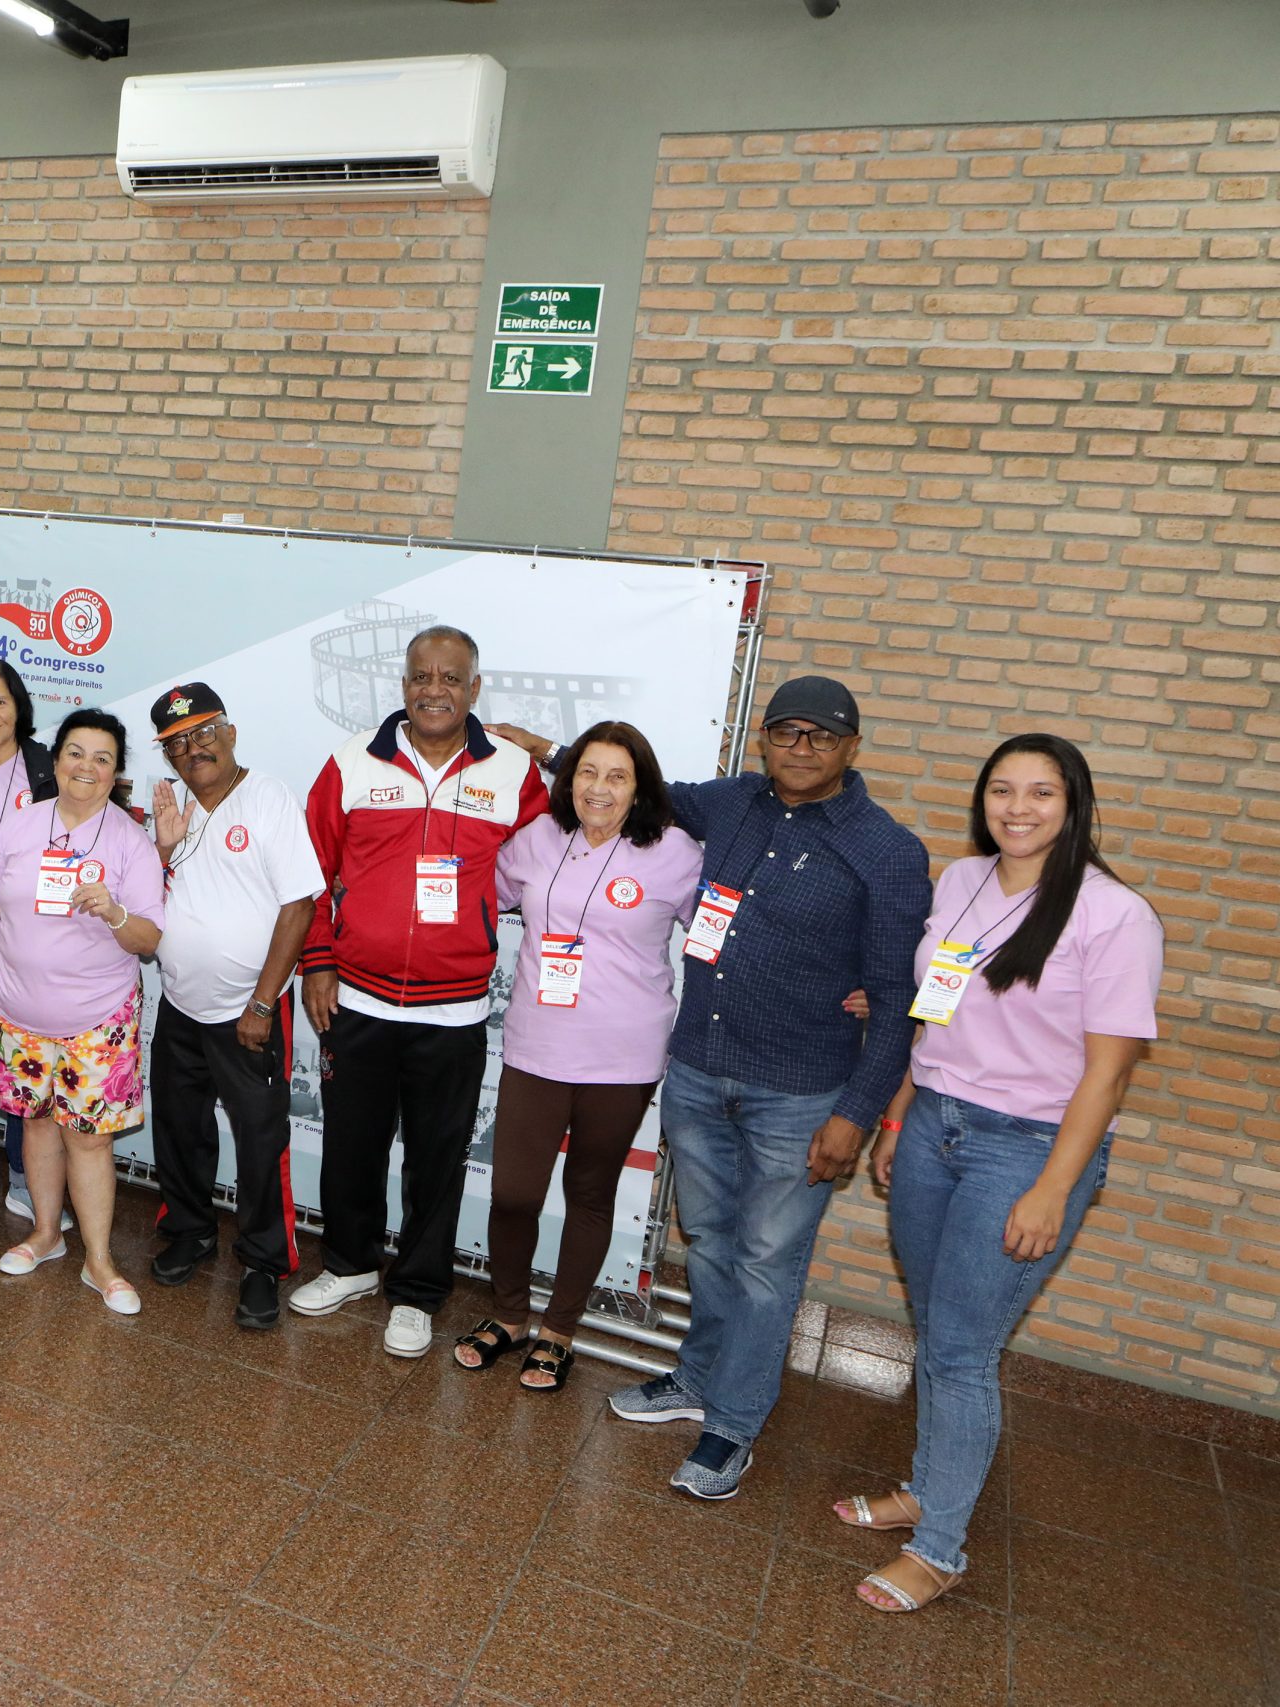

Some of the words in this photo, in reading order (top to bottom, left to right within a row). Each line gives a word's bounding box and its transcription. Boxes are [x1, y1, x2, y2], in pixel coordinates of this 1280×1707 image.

[530, 289, 570, 302] SAÍDA
[539, 305, 558, 316] DE
[503, 318, 591, 330] EMERGÊNCIA
[63, 590, 103, 609] QUÍMICOS
[29, 617, 46, 633] 90
[20, 648, 105, 674] Congresso
[31, 674, 47, 682] para
[47, 676, 74, 687] Ampliar
[75, 678, 103, 690] Direitos
[371, 787, 400, 801] CUT
[304, 1123, 323, 1135] Cong
[467, 1165, 486, 1175] 1980
